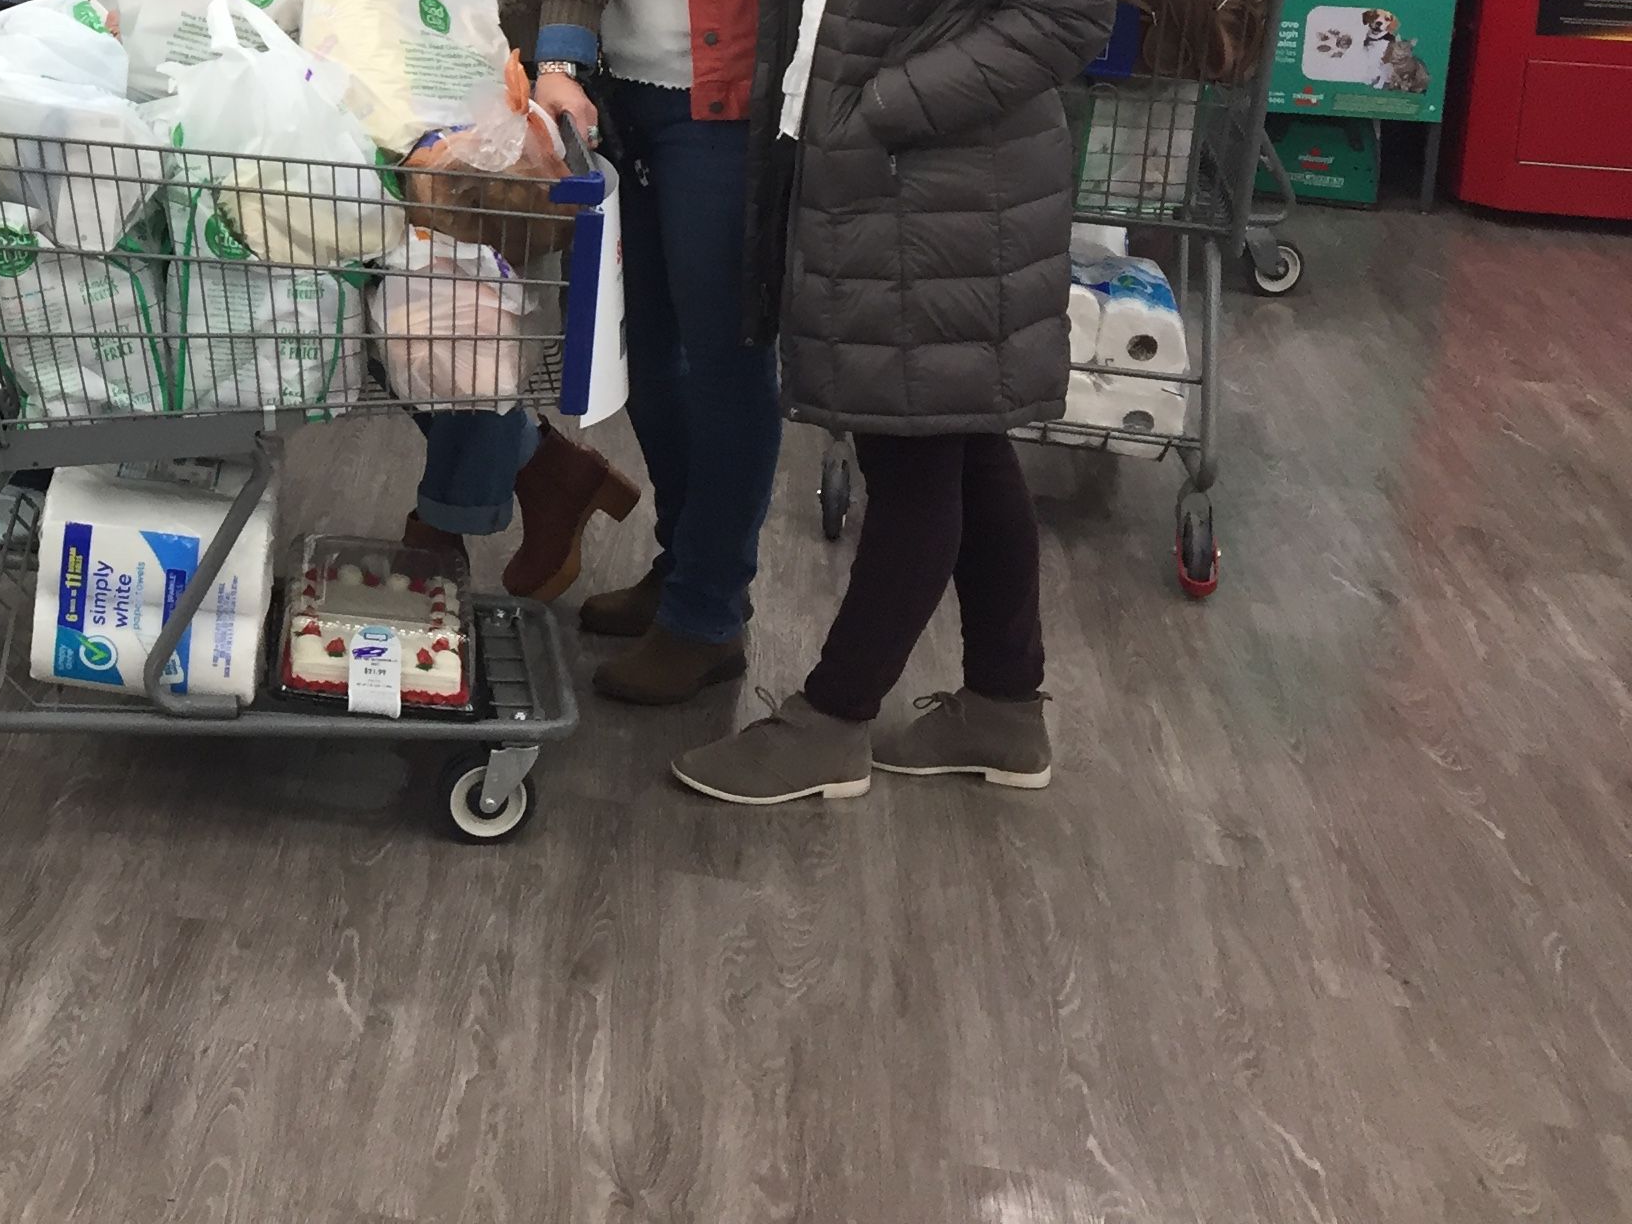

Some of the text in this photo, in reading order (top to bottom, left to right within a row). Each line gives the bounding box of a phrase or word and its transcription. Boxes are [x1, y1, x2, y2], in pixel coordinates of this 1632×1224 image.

[1280, 20, 1300, 29] ove
[1278, 30, 1299, 39] ugh
[64, 572, 82, 589] 11
[89, 560, 114, 626] simply
[113, 573, 132, 628] white
[65, 613, 78, 623] 6
